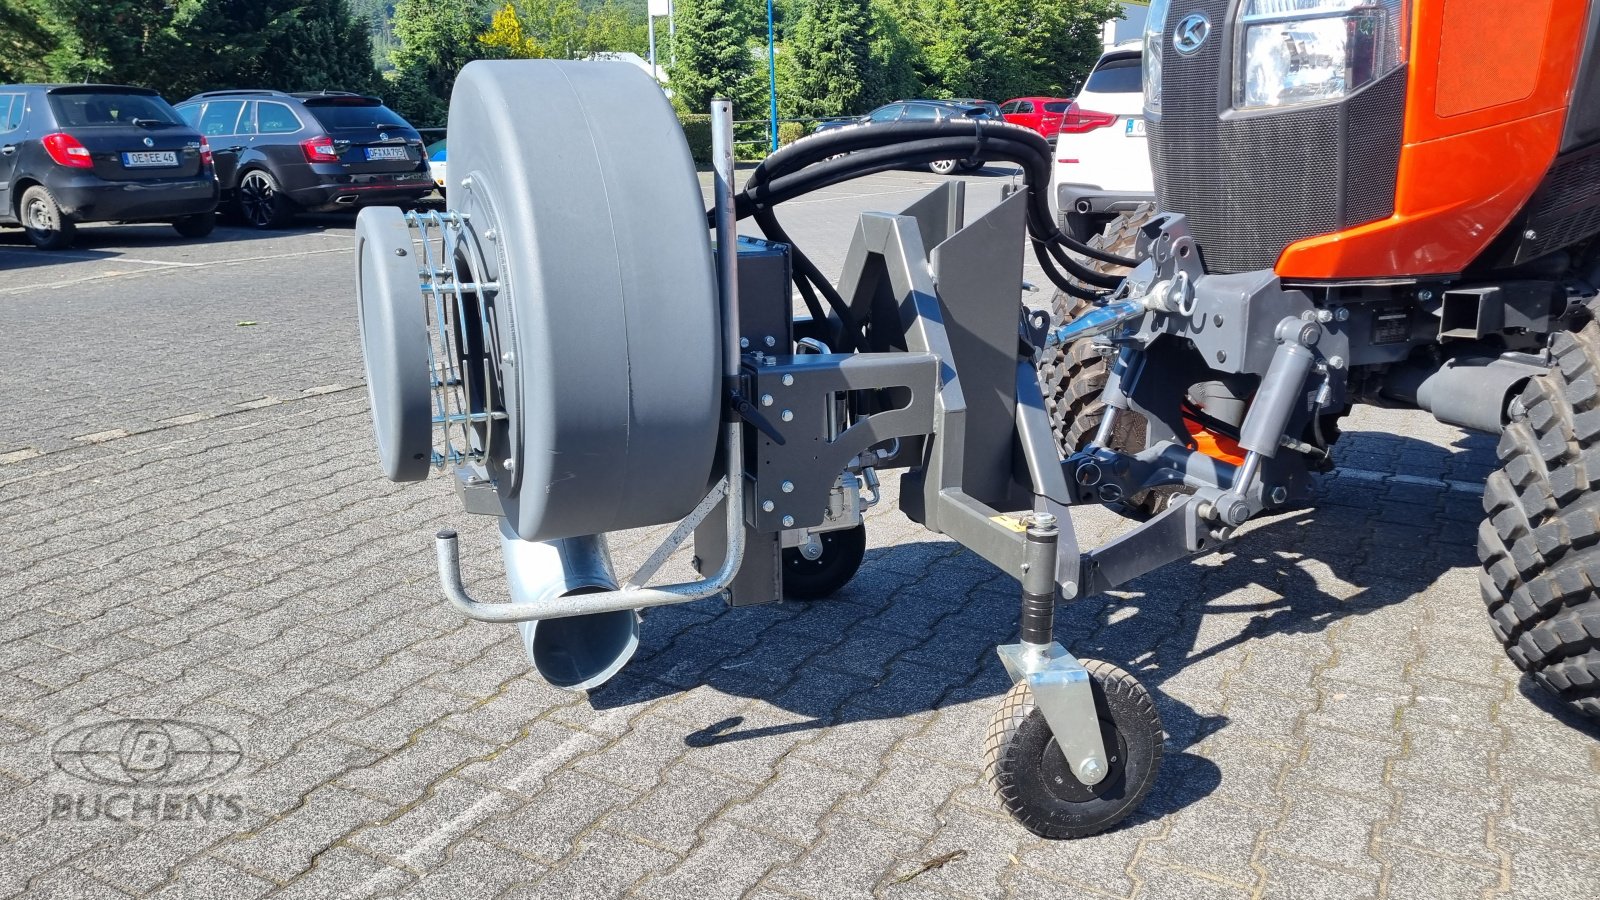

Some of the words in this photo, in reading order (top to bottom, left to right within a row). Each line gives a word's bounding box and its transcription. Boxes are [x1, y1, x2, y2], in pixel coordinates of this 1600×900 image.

[132, 153, 145, 163] OE
[149, 153, 162, 162] EE
[164, 153, 174, 162] 46
